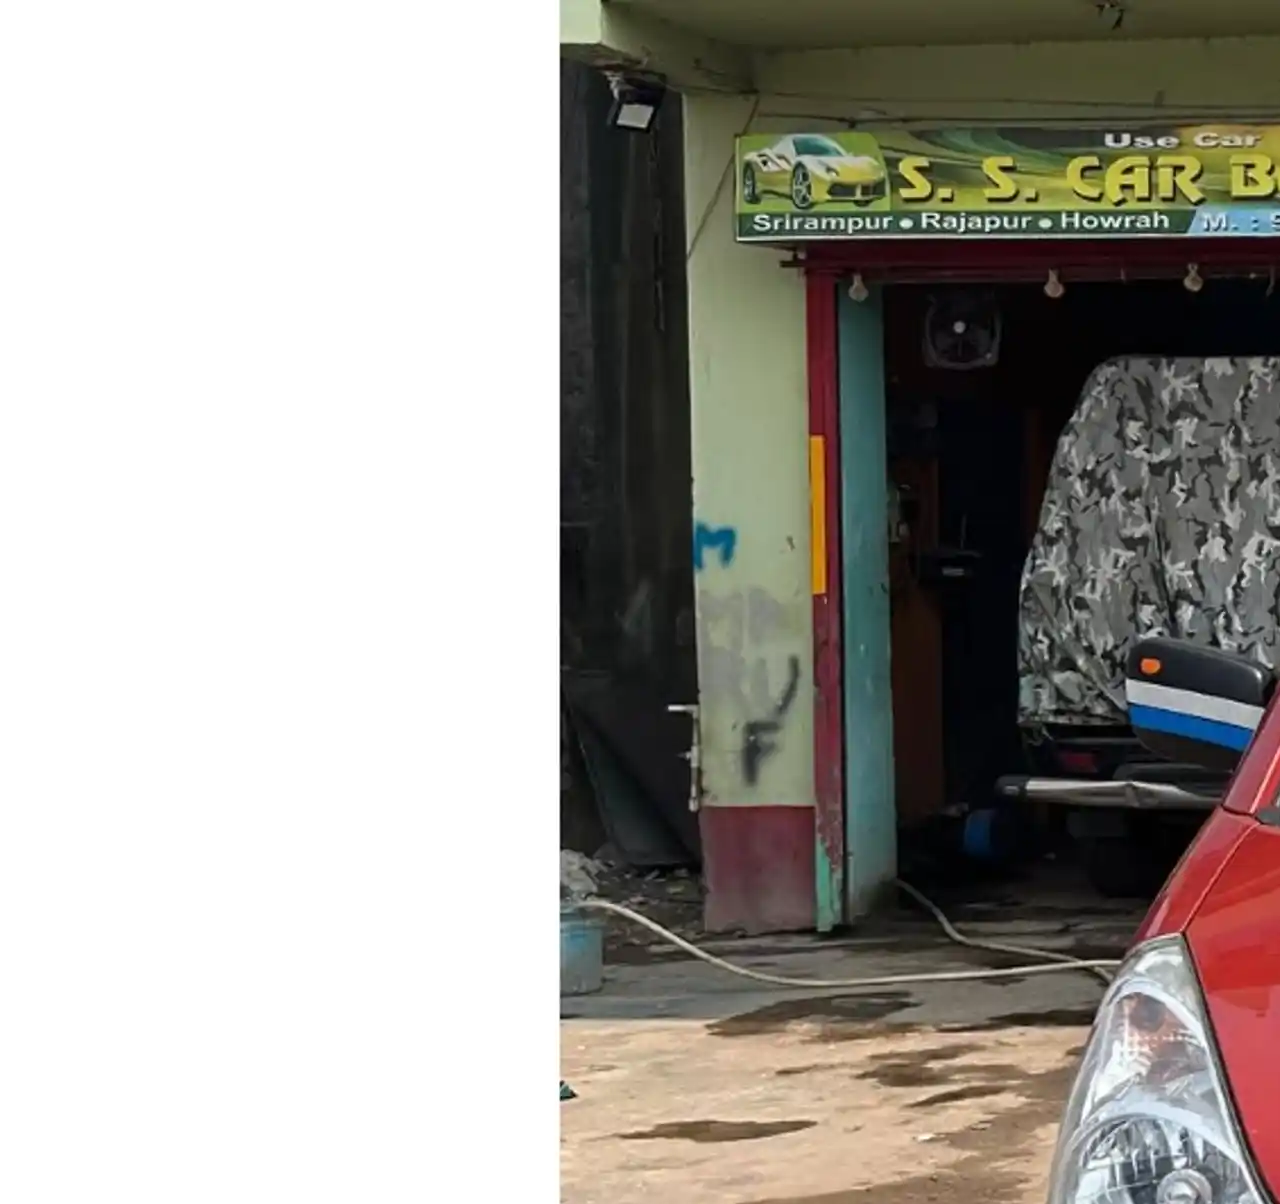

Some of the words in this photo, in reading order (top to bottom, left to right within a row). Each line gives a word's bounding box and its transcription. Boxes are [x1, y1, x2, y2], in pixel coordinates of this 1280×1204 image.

[1104, 132, 1180, 149] Use
[1194, 132, 1262, 148] Car
[898, 155, 954, 202] S.
[982, 156, 1038, 202] S.
[1066, 154, 1206, 206] CAR
[752, 213, 894, 236] Srirampur
[921, 212, 1033, 234] Rajapur
[1060, 210, 1170, 231] Howrah
